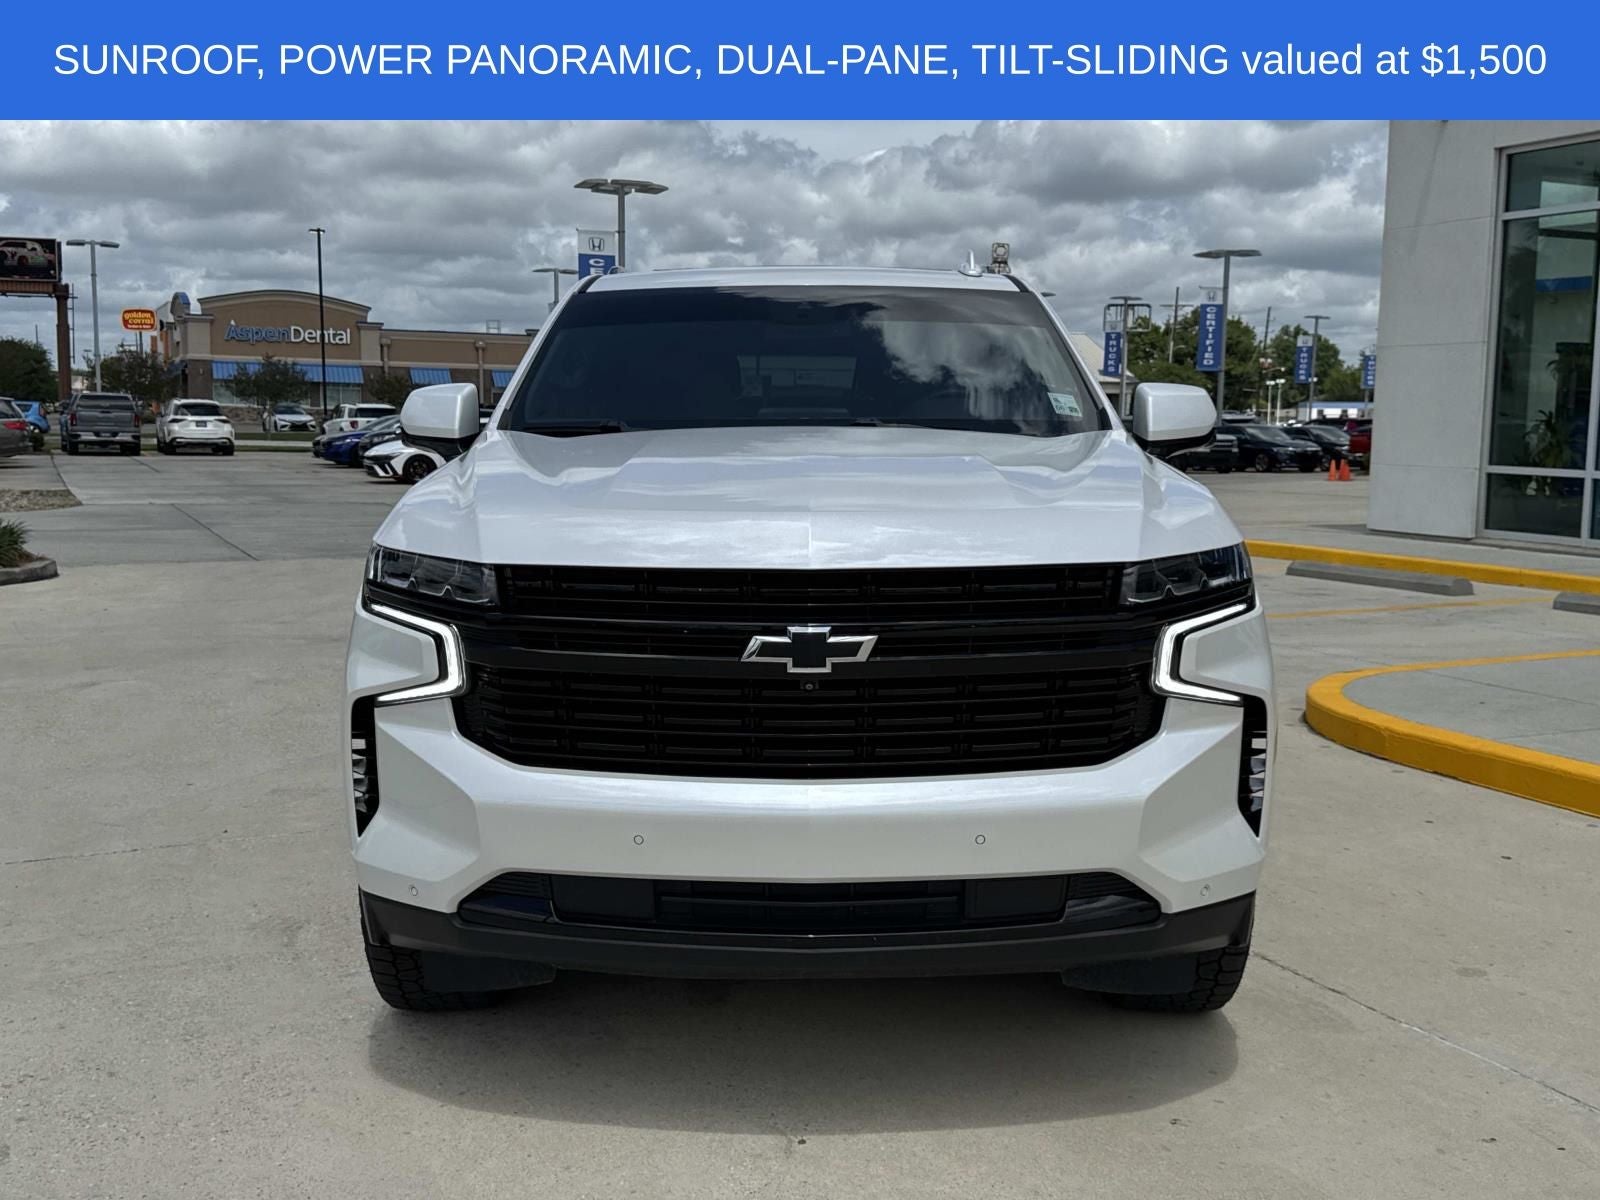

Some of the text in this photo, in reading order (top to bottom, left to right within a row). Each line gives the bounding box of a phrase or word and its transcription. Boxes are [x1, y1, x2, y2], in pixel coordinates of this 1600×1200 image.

[124, 312, 151, 320] golden
[1203, 306, 1217, 366] CERTIFIED
[1107, 333, 1117, 373] TRUCKS
